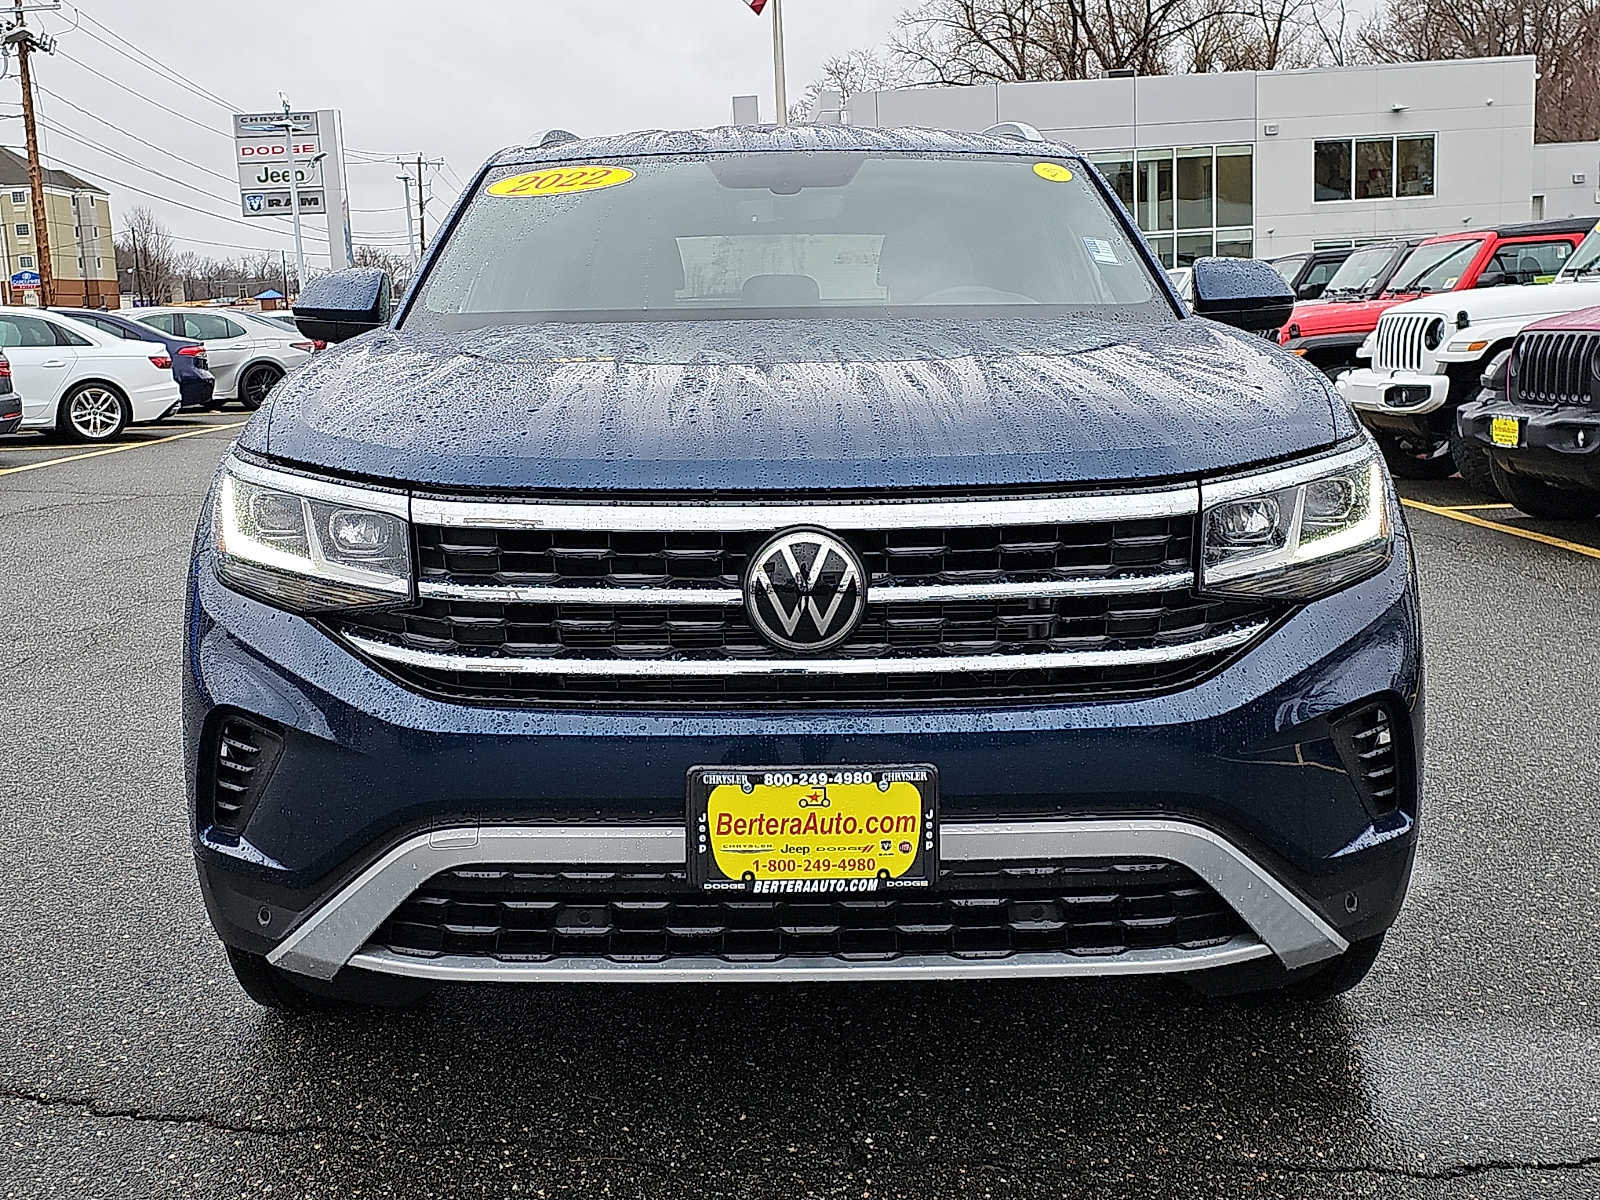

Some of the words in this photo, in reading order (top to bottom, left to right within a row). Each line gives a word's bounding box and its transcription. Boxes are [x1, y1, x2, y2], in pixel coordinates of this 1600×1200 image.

[505, 169, 612, 194] 2022
[702, 774, 748, 785] CHRYSLER
[763, 771, 873, 786] 800-249-4980
[881, 771, 928, 781] CHRYSLER
[716, 812, 917, 836] BerteraAuto.com
[925, 808, 934, 851] Jeep
[698, 812, 707, 854] Jeep
[780, 844, 811, 856] Jeep
[752, 858, 876, 873] 1-800-249-4980
[753, 879, 879, 894] BERTERAAUTO.COM
[886, 880, 929, 888] DODGE
